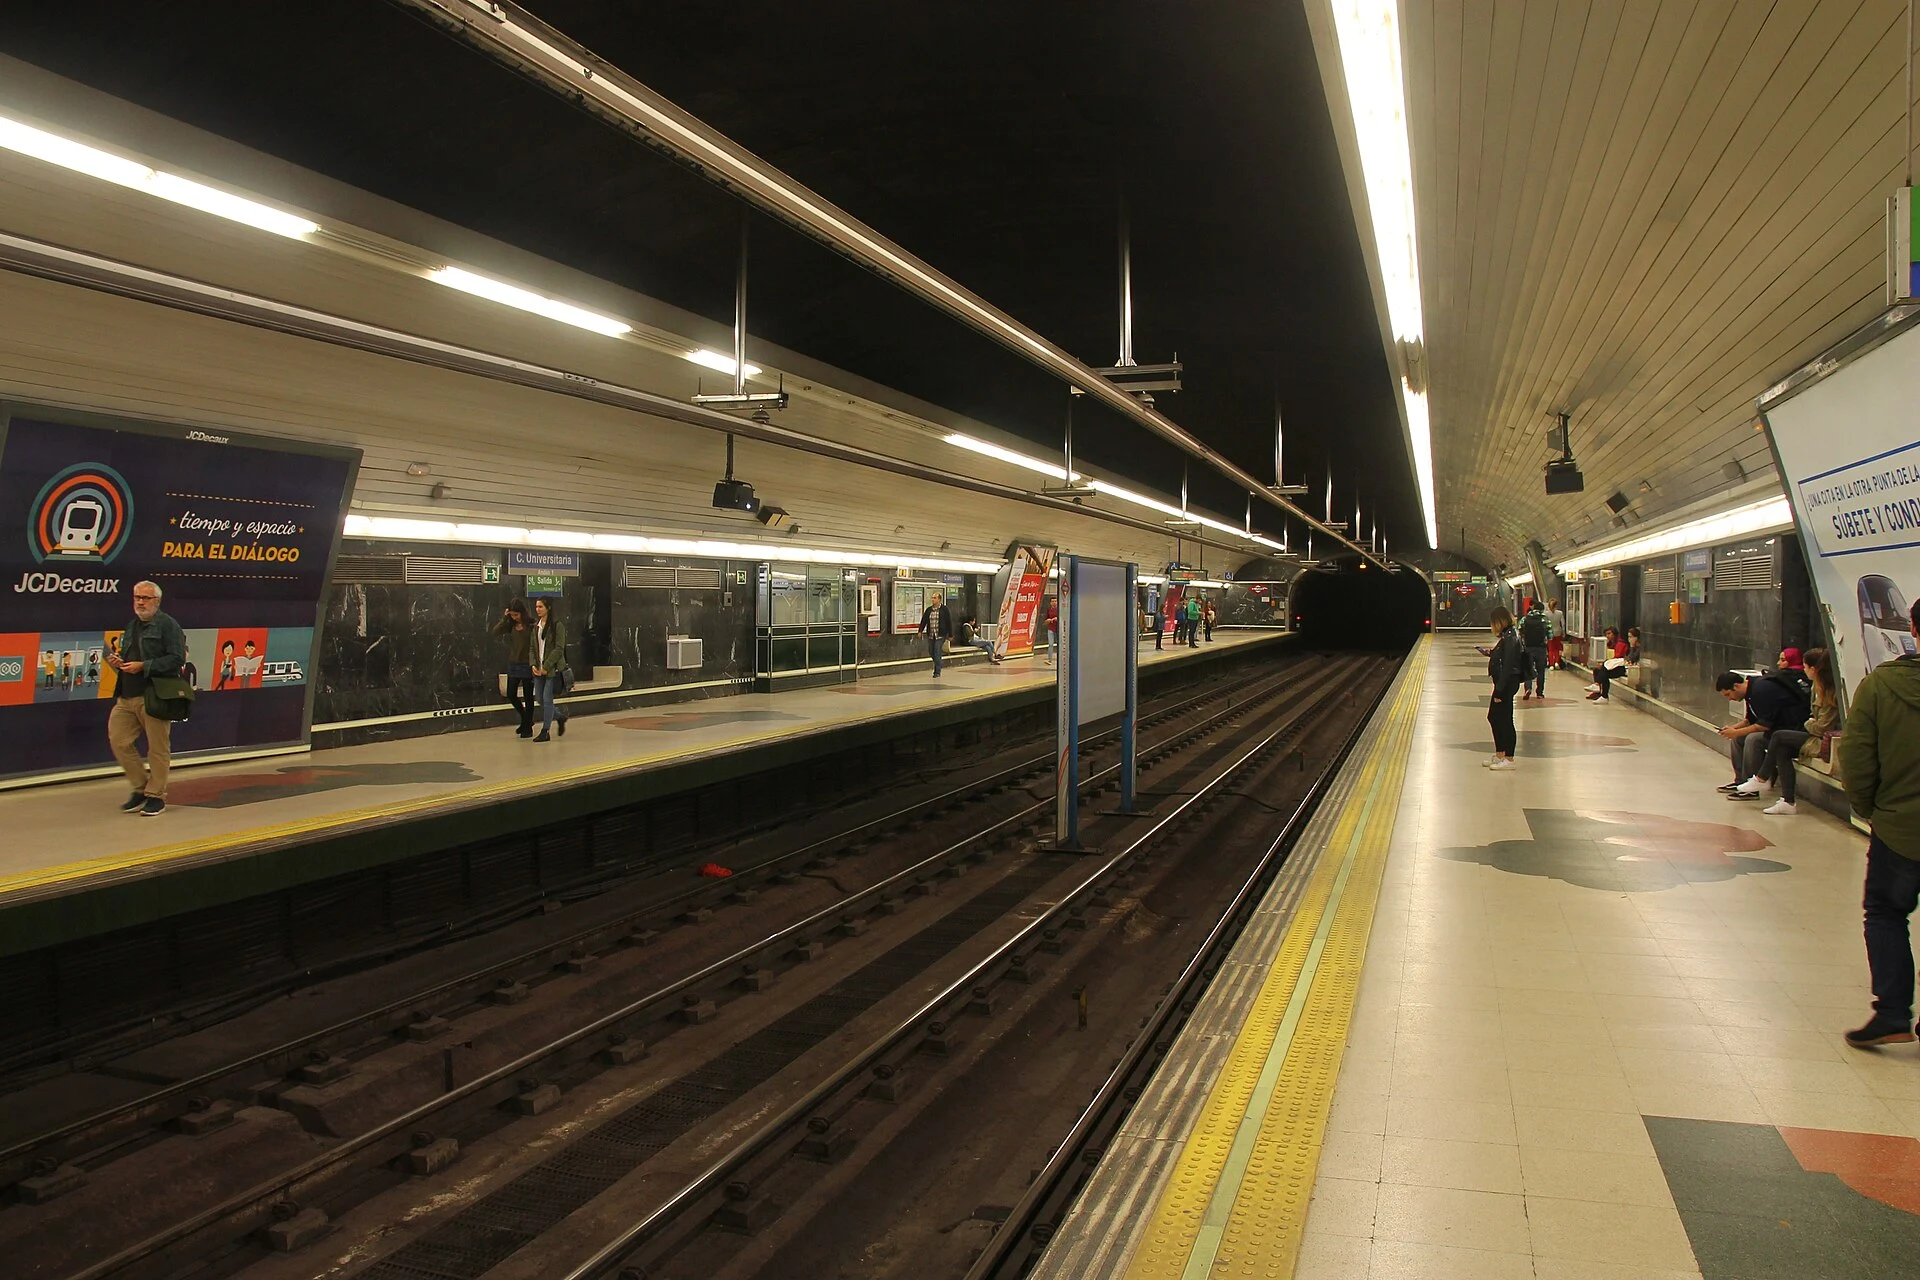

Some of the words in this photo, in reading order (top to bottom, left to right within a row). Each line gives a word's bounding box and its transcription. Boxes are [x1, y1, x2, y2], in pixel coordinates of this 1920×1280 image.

[185, 430, 229, 444] JCDecaux
[1820, 489, 1836, 505] CITA
[1835, 485, 1846, 501] EN
[1843, 482, 1855, 499] LA
[1853, 478, 1873, 496] OTRA
[1872, 470, 1899, 492] PUNTA
[1896, 467, 1909, 486] DE
[179, 510, 231, 536] tiempo
[233, 521, 243, 538] y
[246, 520, 297, 539] espacio
[1832, 506, 1876, 539] SÚBETE
[1873, 506, 1885, 533] Y
[1884, 497, 1920, 532] COND
[162, 541, 204, 559] PARA
[208, 543, 227, 560] EL
[230, 541, 300, 563] DIÁLOGO
[516, 552, 525, 563] C.
[526, 552, 572, 565] Universitaria
[14, 572, 120, 593] JCDecaux
[537, 576, 553, 585] Salida
